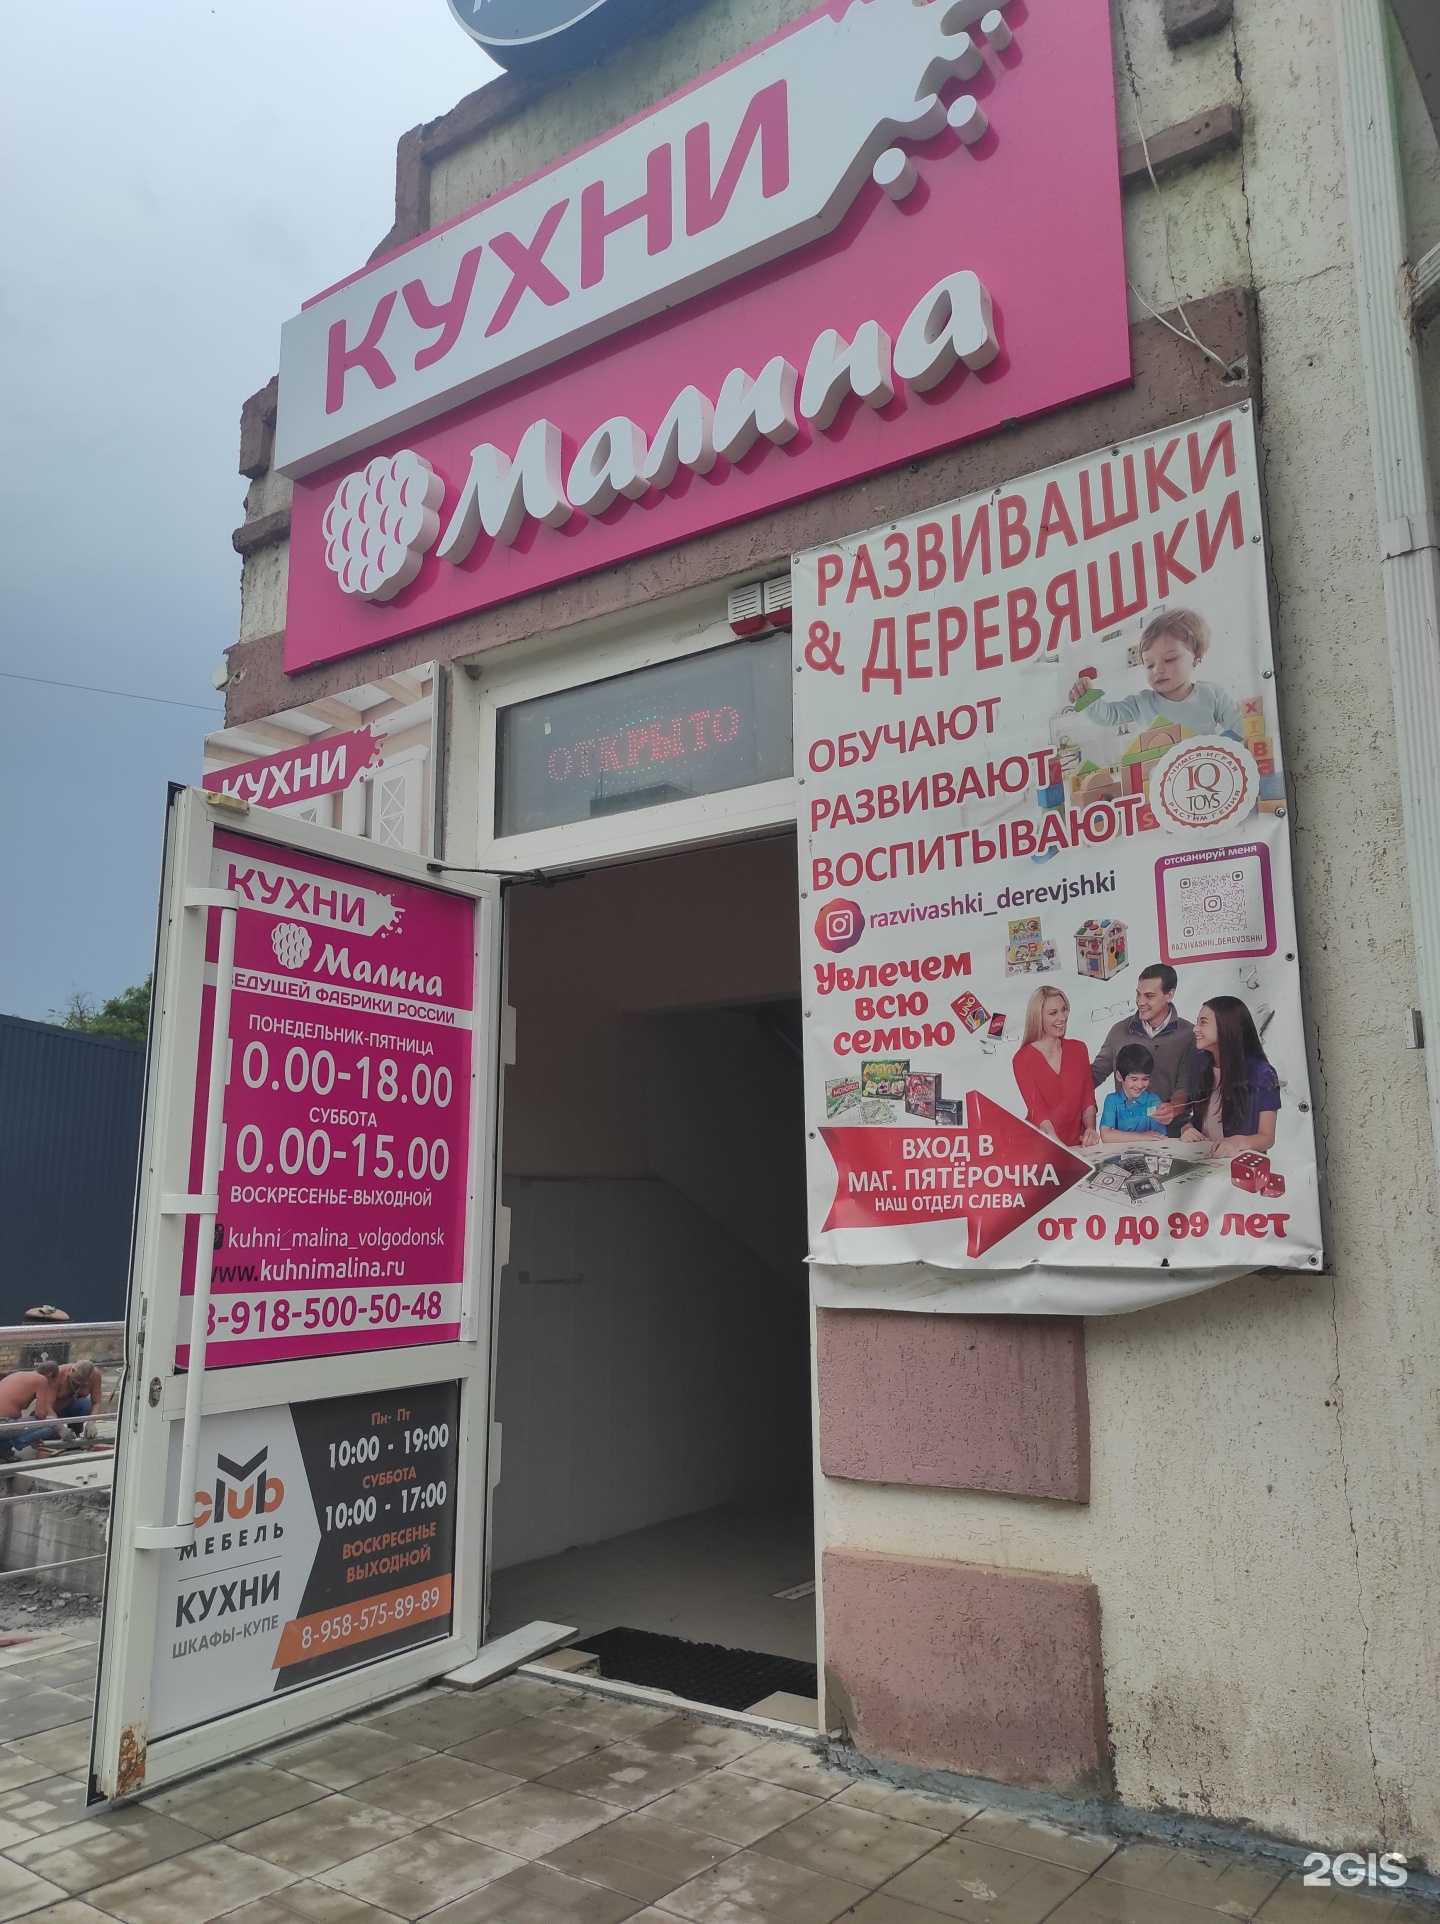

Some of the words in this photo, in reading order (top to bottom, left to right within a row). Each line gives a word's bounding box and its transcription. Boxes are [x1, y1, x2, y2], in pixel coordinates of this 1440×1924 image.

[326, 79, 789, 414] КУХНИ
[436, 270, 998, 565] Малина
[816, 420, 1237, 607] РАЗВИВАШКИ
[804, 620, 845, 675] &
[861, 490, 1245, 696] ДЕРЕВЯШКИ
[548, 705, 740, 784] ОТКРЫТО
[808, 697, 1002, 773] ОБУЧАЮТ
[222, 744, 347, 804] КУХНИ
[810, 748, 1054, 832] РАЗВИВАЮТ
[1185, 762, 1224, 793] IQ
[1186, 792, 1221, 812] TOYS
[812, 796, 1142, 891] ВОСПИТЫВАЮТ
[1164, 847, 1226, 866] отсканируй
[1228, 845, 1257, 856] меня
[227, 863, 365, 928] КУХНИ
[870, 869, 1116, 928] razvivashki_derevjshki
[313, 943, 443, 997] Малина
[813, 951, 972, 995] Увлечем
[231, 972, 310, 999] ЕДУЩЕЙ
[315, 987, 393, 1014] ФАБРИКИ
[397, 1002, 455, 1025] РОССИИ
[855, 991, 929, 1021] всю
[249, 1014, 434, 1055] ПОНЕДЕЛЬНИК-ПЯТНИЦА
[834, 1021, 956, 1056] семью
[309, 1106, 377, 1128] СУББОТА
[902, 1135, 970, 1161] ВХОД
[978, 1134, 994, 1156] В
[230, 1184, 432, 1207] ВОСКРЕСЕНЬЕ-ВЫХОДНОЙ
[848, 1170, 897, 1193] МАГ.
[905, 1162, 1060, 1191] ПЯТЁРОЧКА
[875, 1197, 907, 1212] НАШ
[912, 1194, 963, 1213] ОТДЕЛ
[968, 1193, 1025, 1209] СЛЕВА
[228, 1225, 444, 1251] kuhni_malina_volgodonsk
[1037, 1217, 1077, 1240] от
[1085, 1214, 1106, 1240] 0
[1115, 1215, 1160, 1246] до
[1168, 1211, 1209, 1239] 99
[1220, 1212, 1291, 1239] лет
[328, 1434, 380, 1469] 10:00
[403, 1424, 449, 1454] 19:00
[362, 1466, 417, 1489] СУББОТА
[325, 1496, 376, 1531] 10:00
[401, 1481, 447, 1514] 17:00
[177, 1523, 284, 1561] МЕБЕЛЬ
[342, 1521, 437, 1560] ВОСКРЕСЕНЬЕ
[346, 1546, 431, 1584] ВЫХОДНОЙ
[175, 1570, 280, 1628] КУХНИ
[301, 1587, 440, 1649] 8-958-575-89-89
[172, 1614, 279, 1659] ШКАФЫ-КУПЕ
